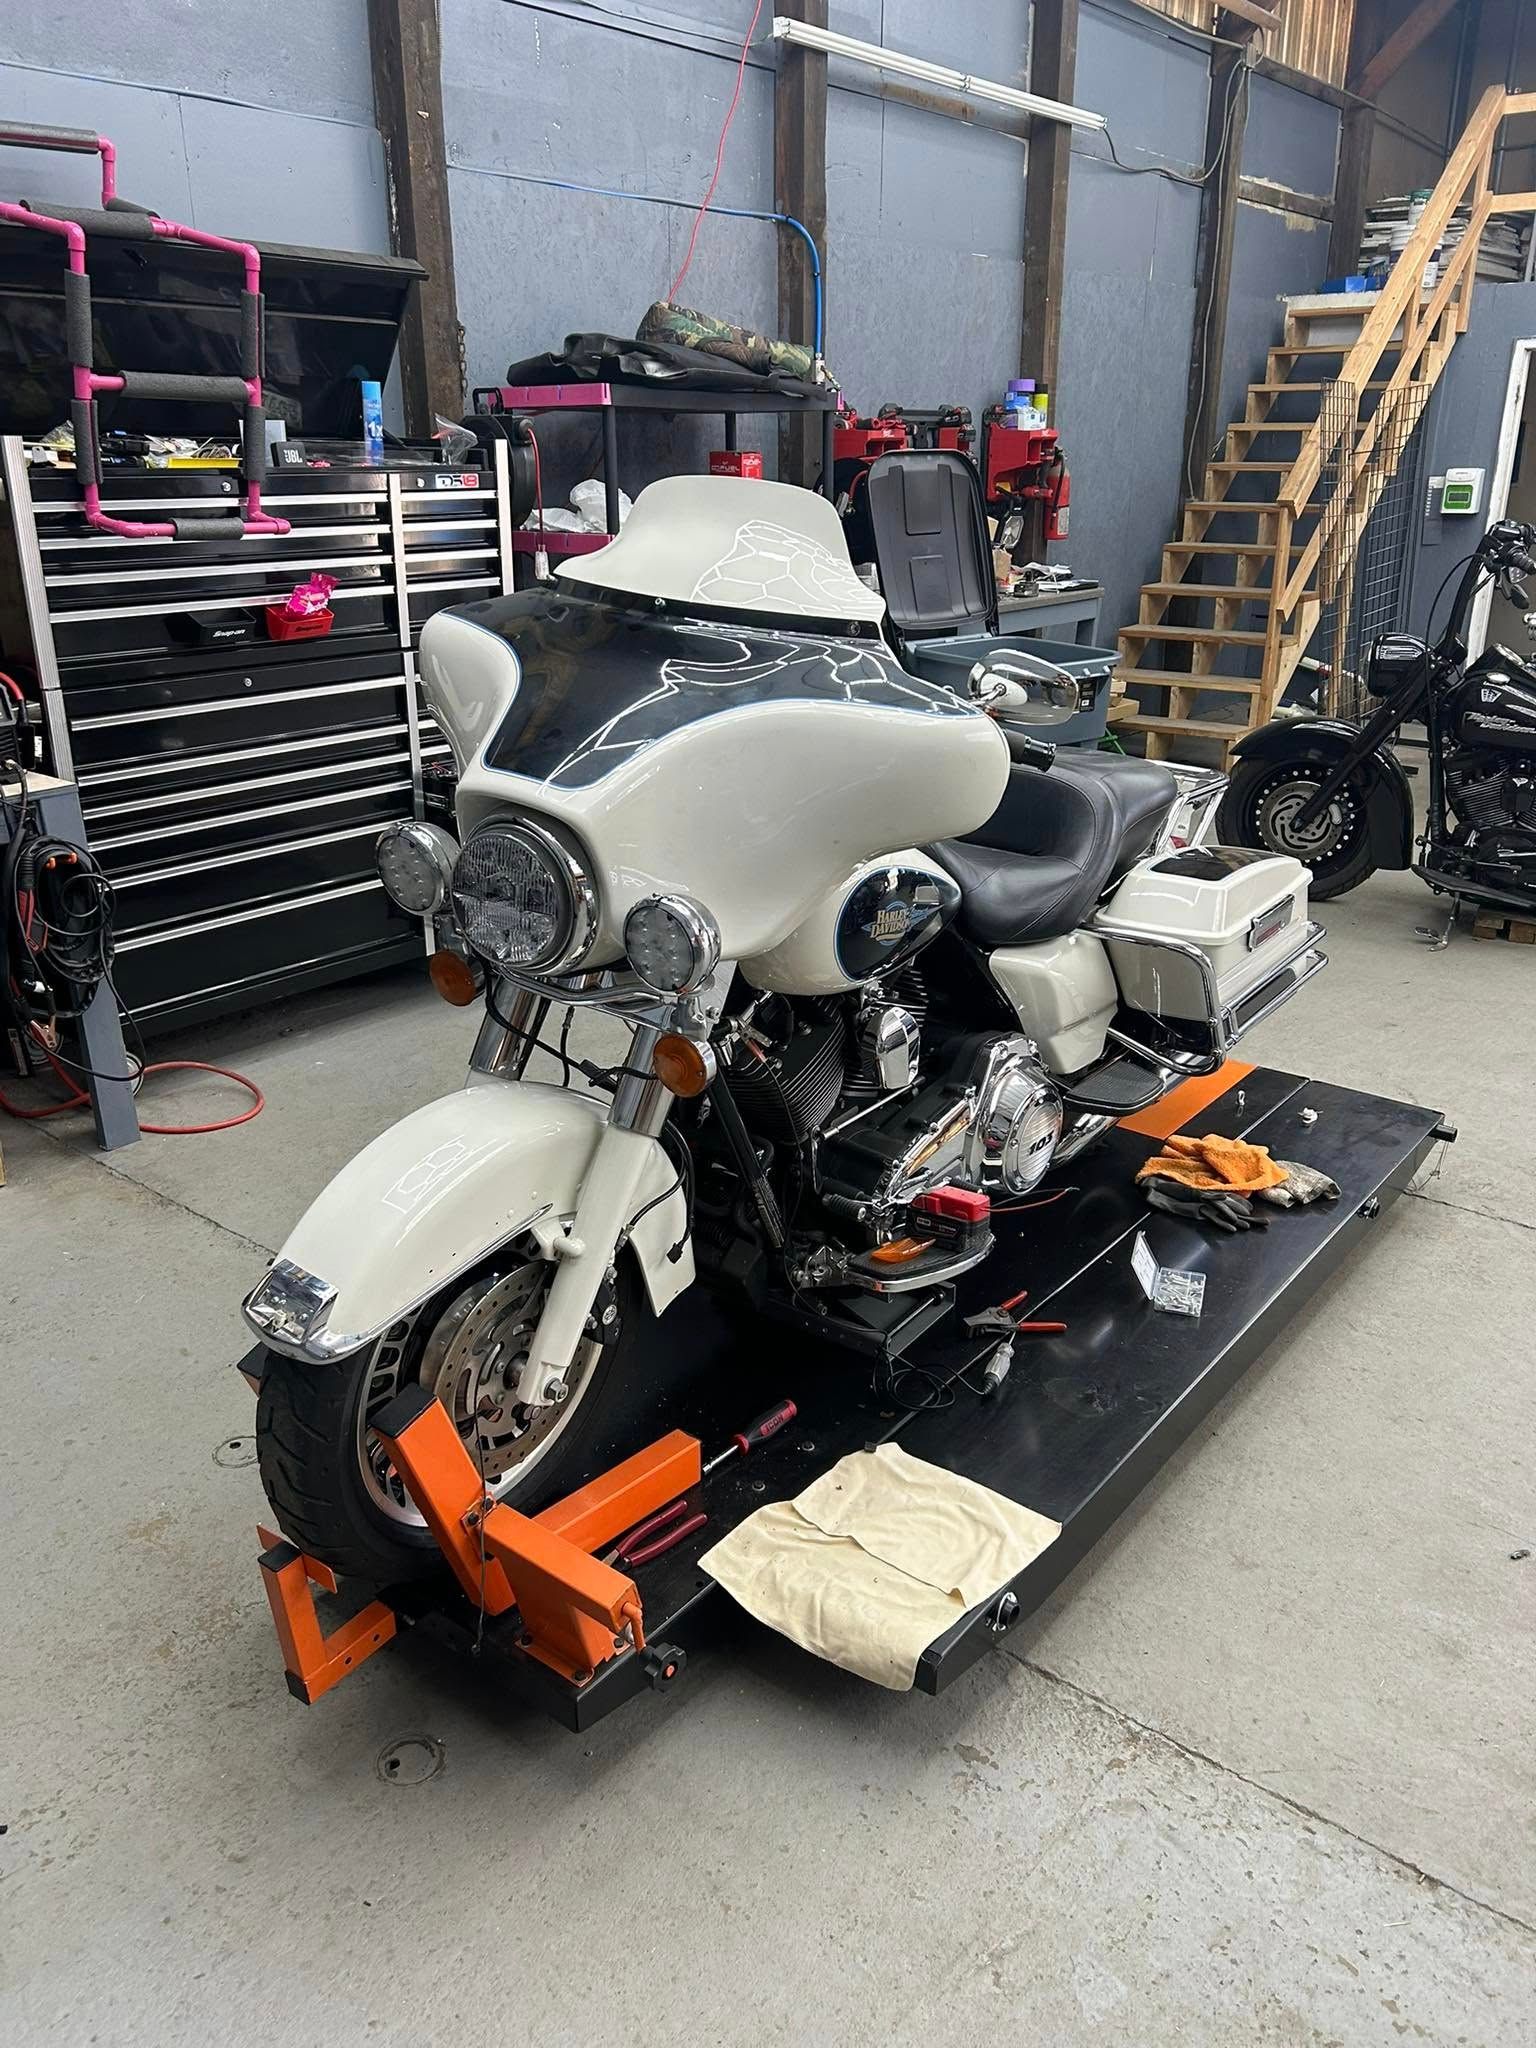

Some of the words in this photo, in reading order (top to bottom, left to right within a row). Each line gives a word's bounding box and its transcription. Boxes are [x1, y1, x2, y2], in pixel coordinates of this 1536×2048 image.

[283, 449, 303, 463] JBL
[1029, 1129, 1055, 1156] 103
[765, 1412, 784, 1432] ICON
